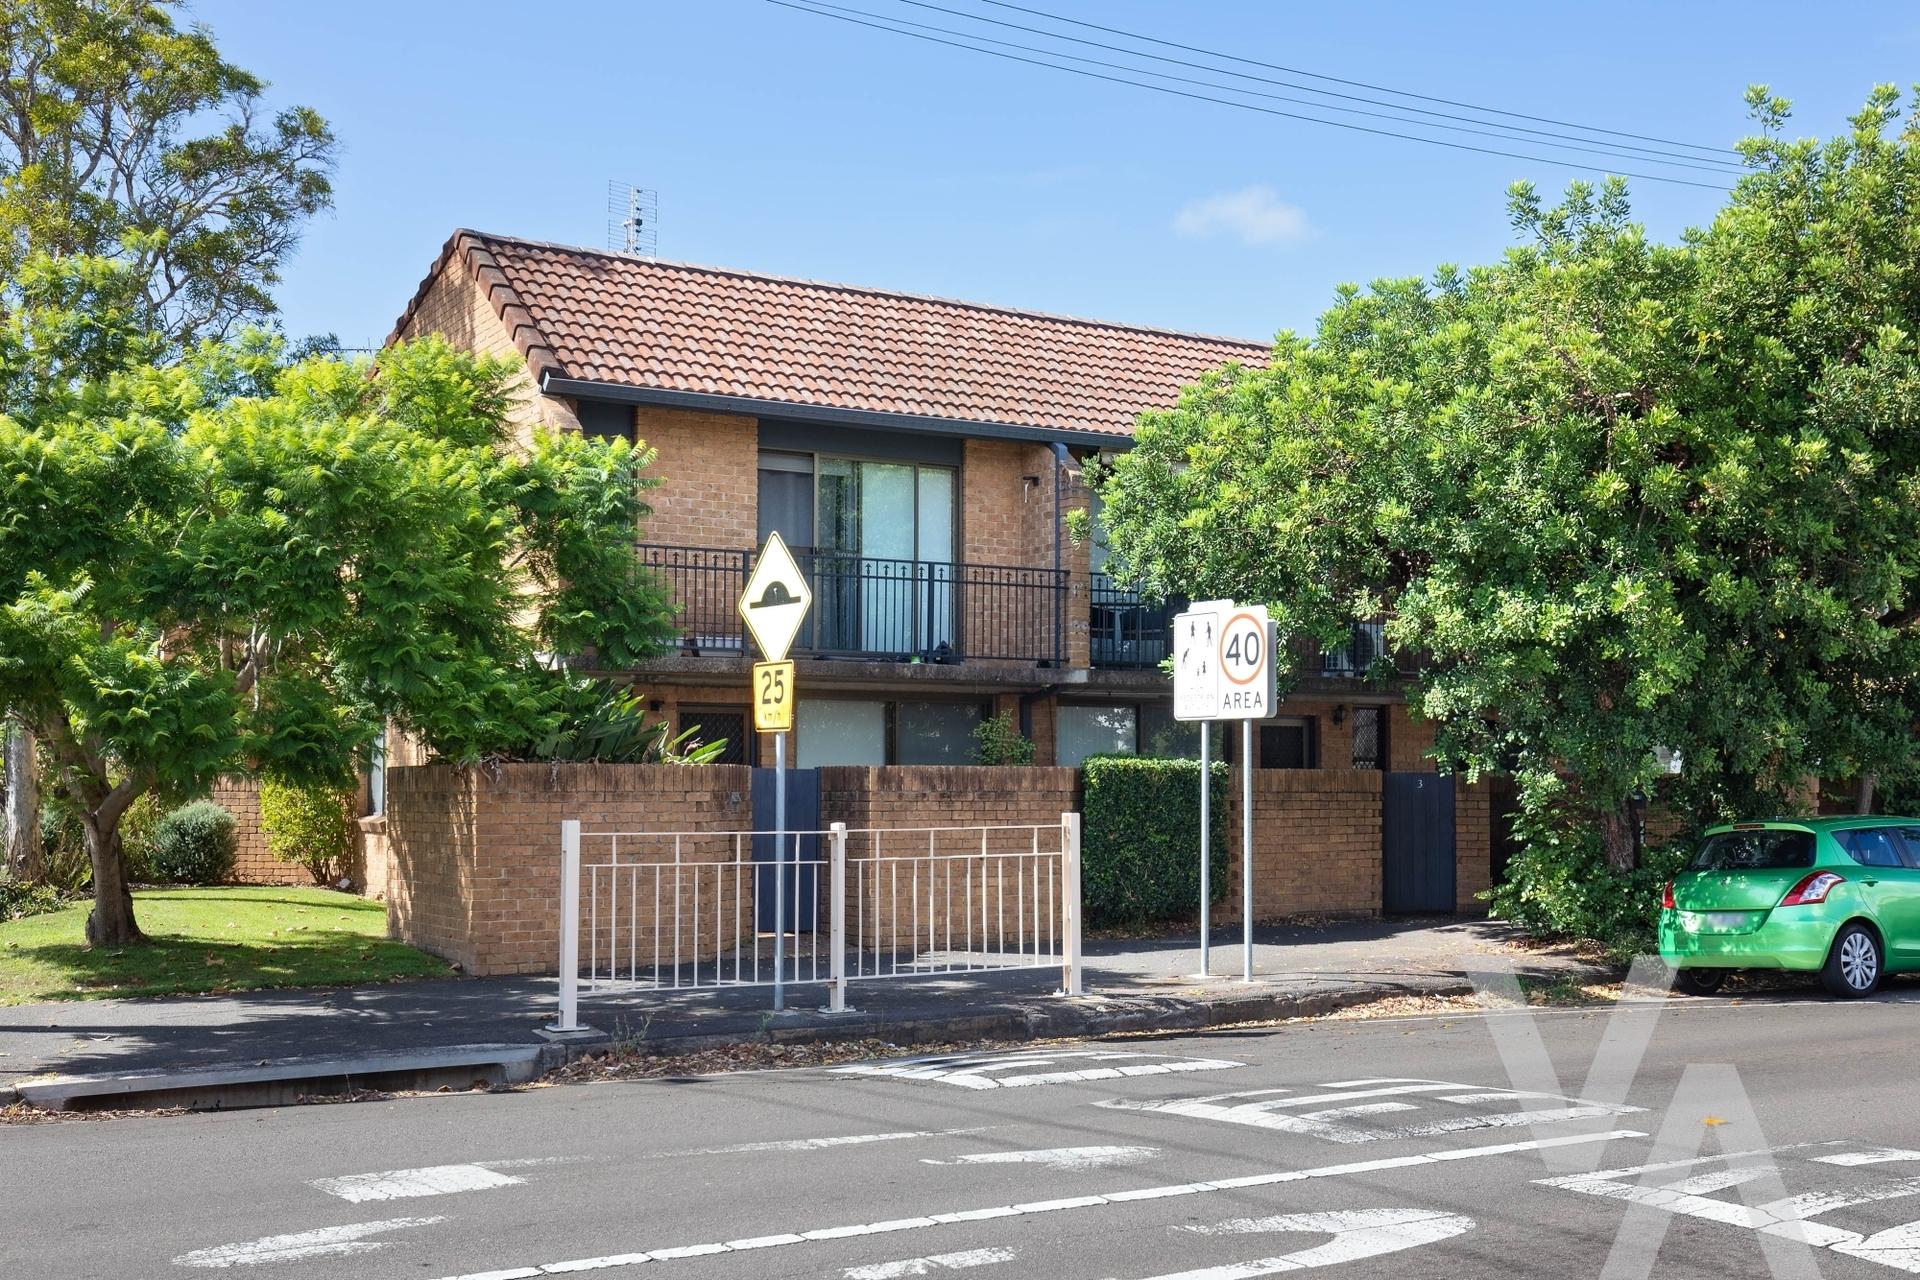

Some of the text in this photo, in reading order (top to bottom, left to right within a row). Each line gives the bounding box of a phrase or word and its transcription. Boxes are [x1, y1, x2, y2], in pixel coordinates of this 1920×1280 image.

[1225, 632, 1260, 666] 40
[762, 670, 784, 704] 25
[1222, 691, 1263, 710] AREA
[1417, 779, 1423, 789] 3
